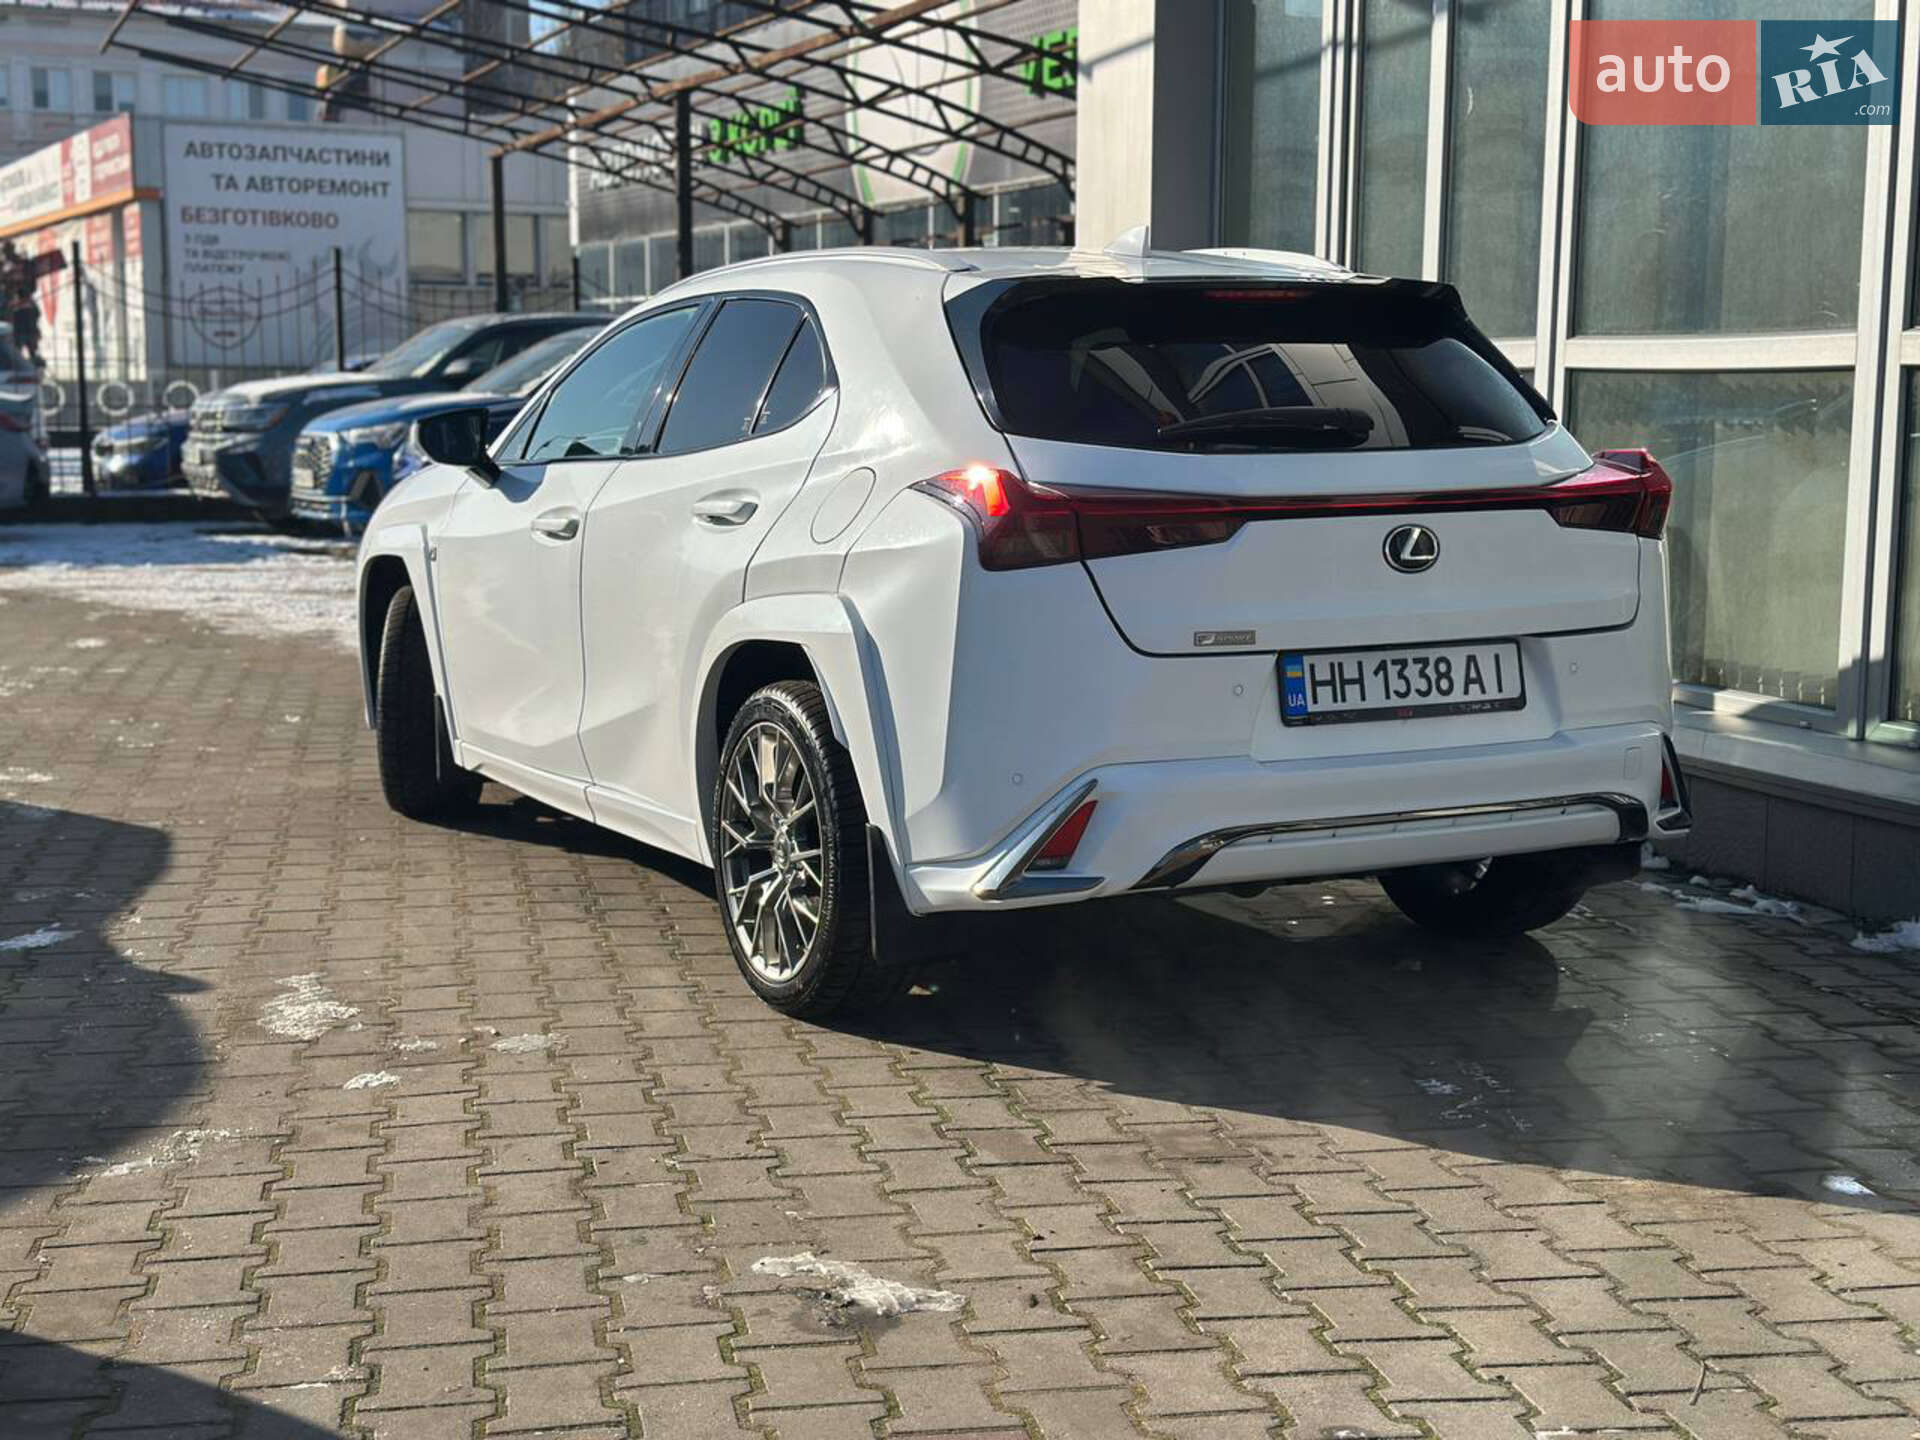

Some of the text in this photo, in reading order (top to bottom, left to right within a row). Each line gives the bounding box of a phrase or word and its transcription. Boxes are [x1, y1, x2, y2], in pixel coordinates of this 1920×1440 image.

[184, 140, 390, 167] АВТОЗАПЧАСТИНИ
[211, 173, 390, 197] ТА АВТОРЕМОНТ
[181, 205, 339, 229] БЕЗГОТІВКОВО
[1373, 655, 1454, 700] 1338
[1288, 692, 1305, 707] UA
